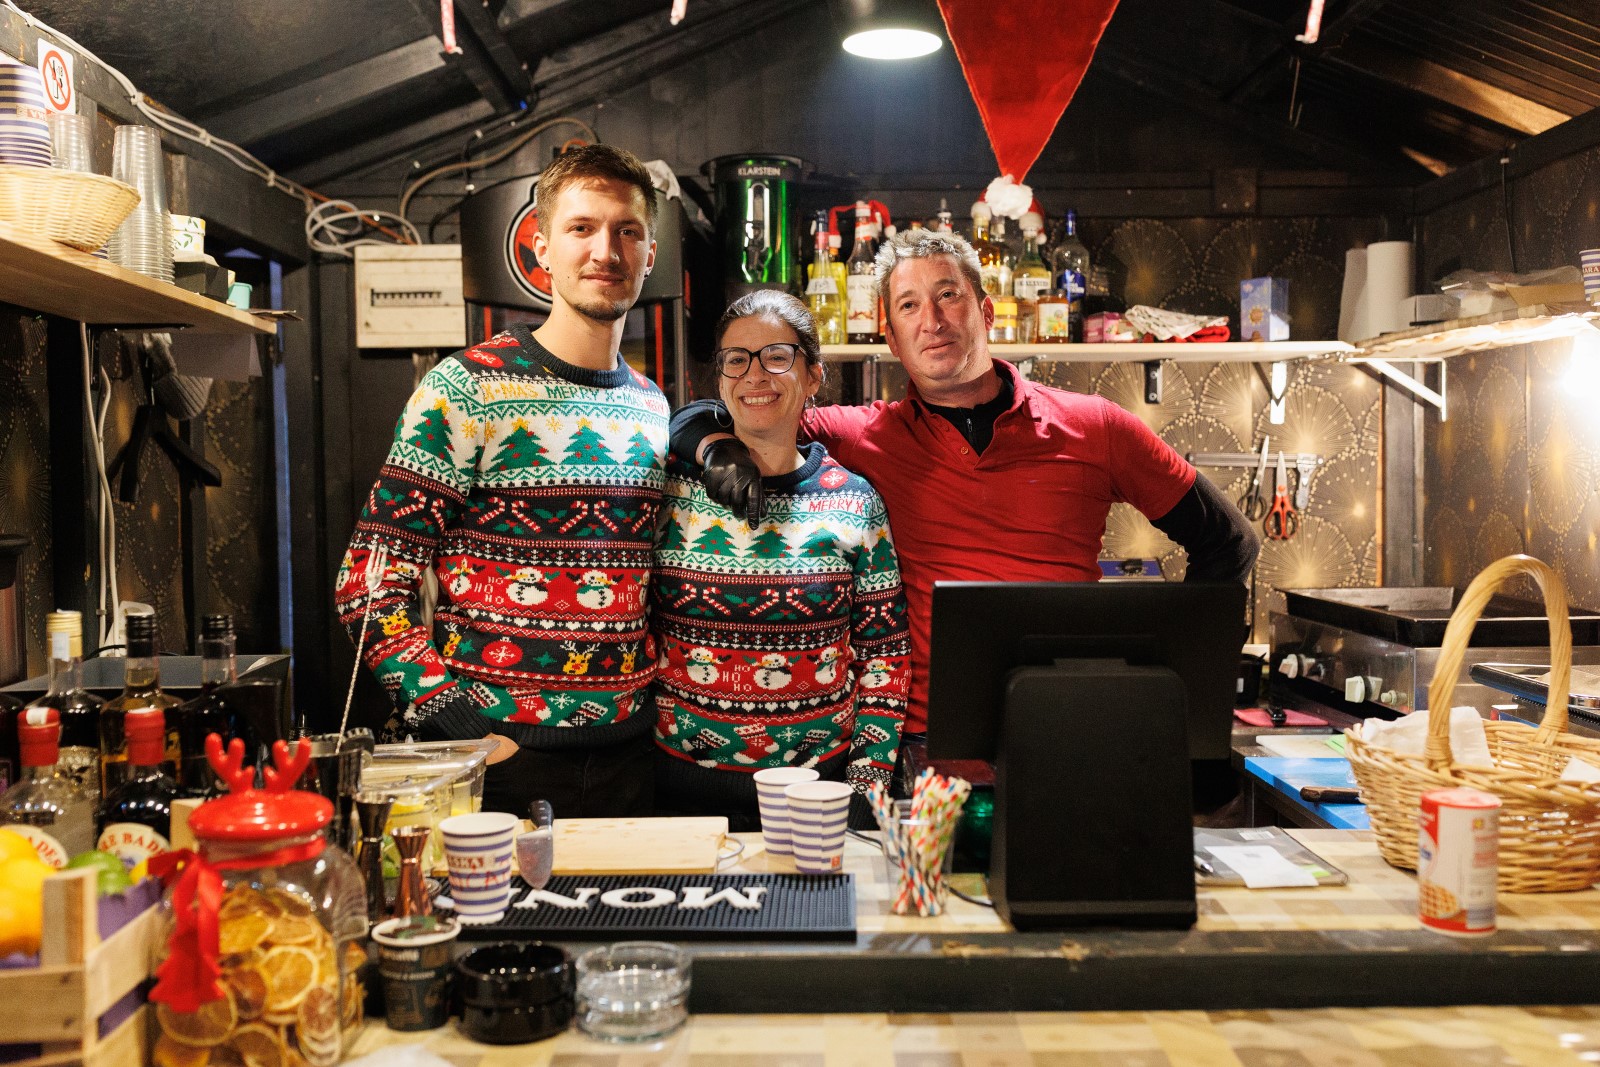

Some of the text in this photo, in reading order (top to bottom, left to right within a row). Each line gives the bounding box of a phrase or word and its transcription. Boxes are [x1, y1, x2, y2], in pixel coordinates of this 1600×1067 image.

[545, 385, 599, 400] MERRY
[808, 499, 852, 513] MERRY
[488, 576, 503, 585] HO
[474, 583, 494, 595] HO
[628, 584, 638, 592] HO
[485, 593, 504, 605] HO
[618, 592, 633, 603] HO
[628, 603, 638, 611] HO
[734, 664, 751, 672] HO
[722, 671, 741, 683] HO
[733, 683, 752, 692] HO
